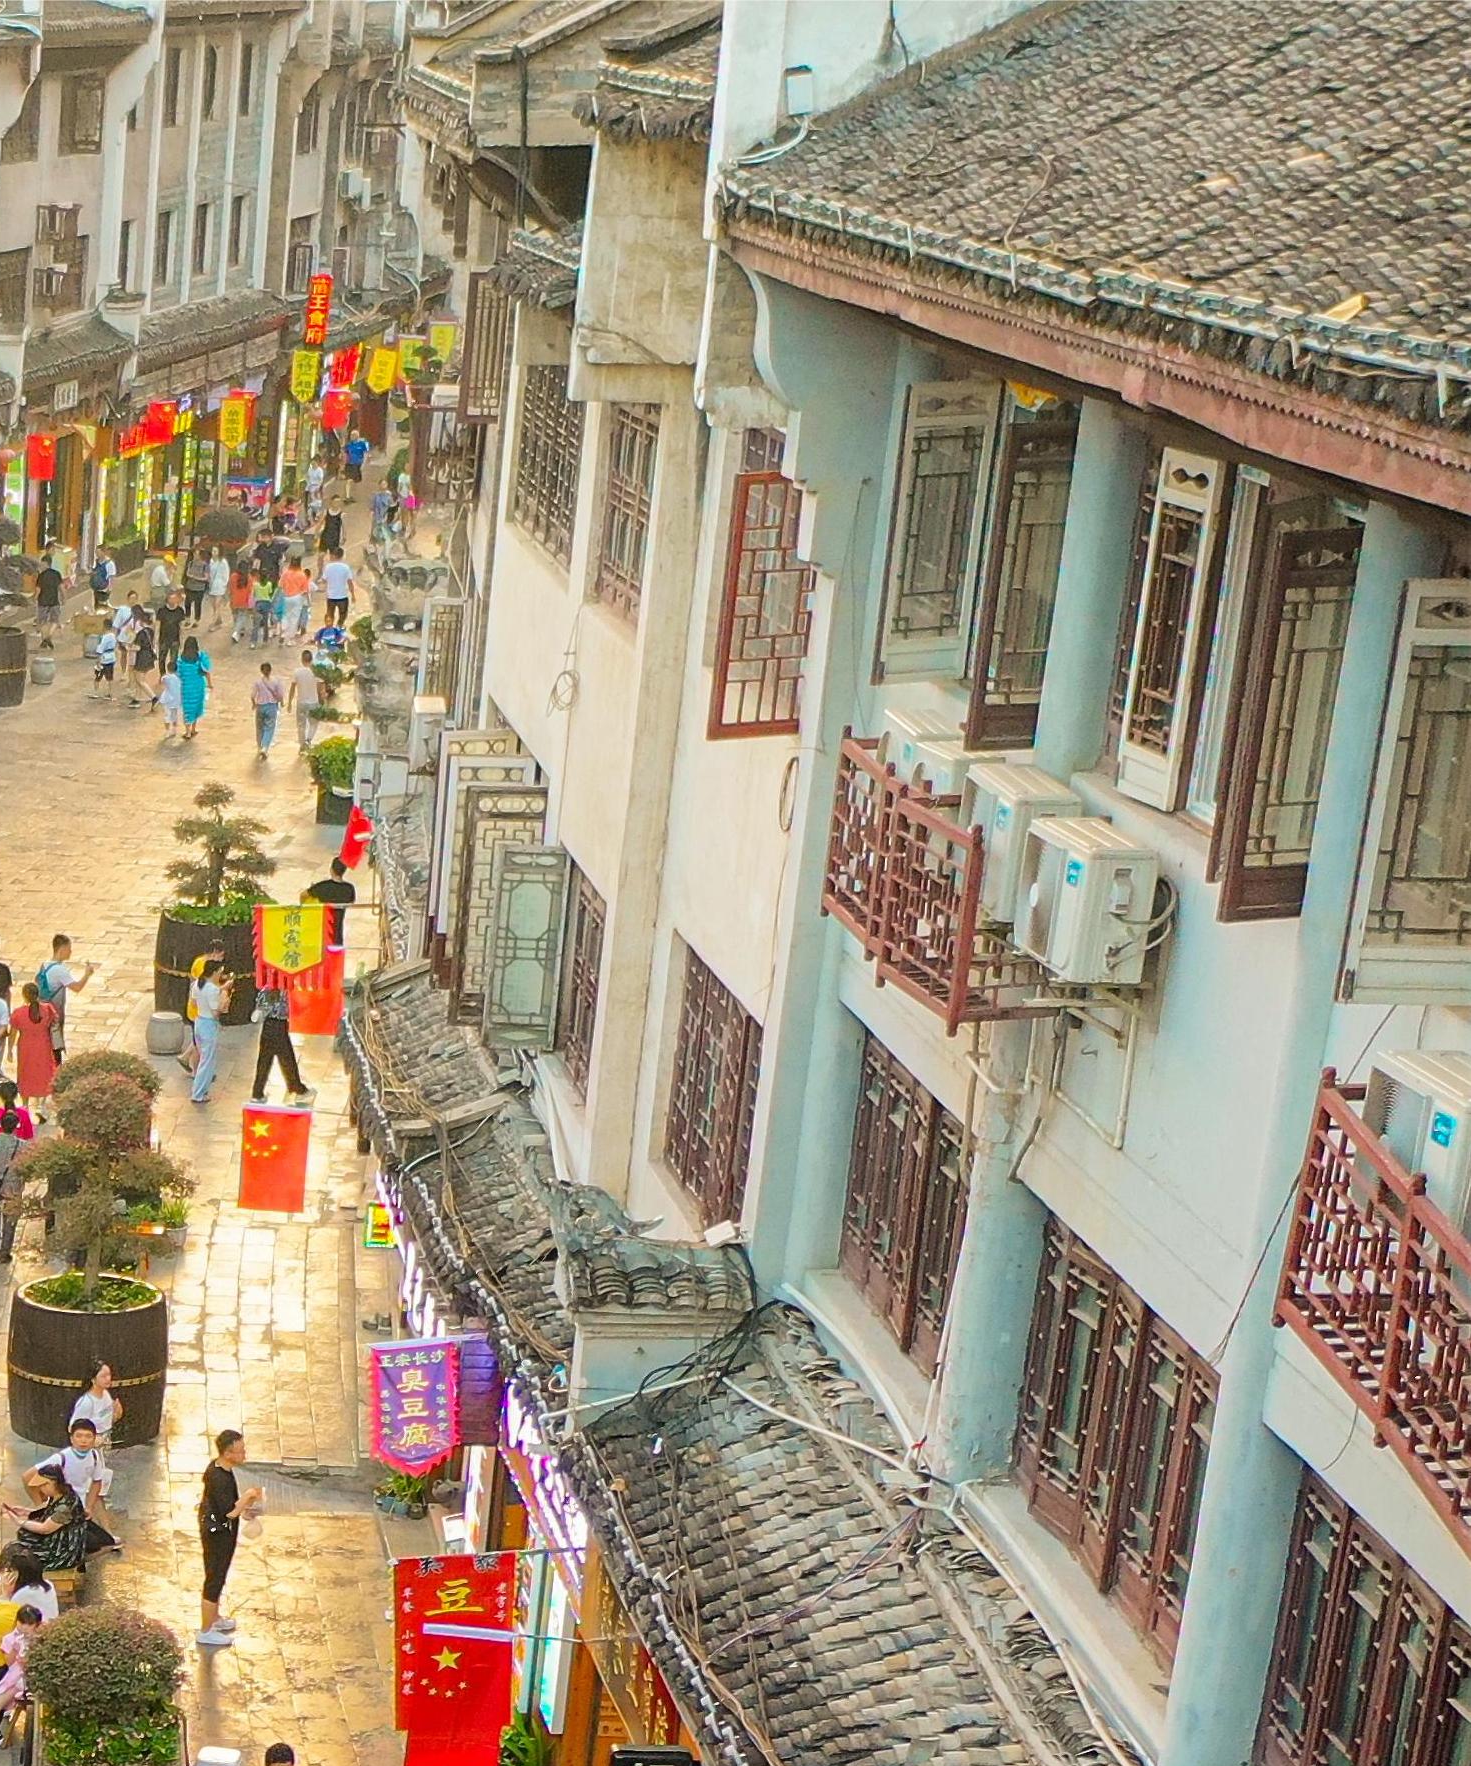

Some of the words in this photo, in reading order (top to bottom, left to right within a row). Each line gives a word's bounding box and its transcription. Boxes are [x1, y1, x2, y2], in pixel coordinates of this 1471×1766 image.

[396, 1368, 431, 1448] 臭豆腐
[423, 1578, 485, 1617] 豆
